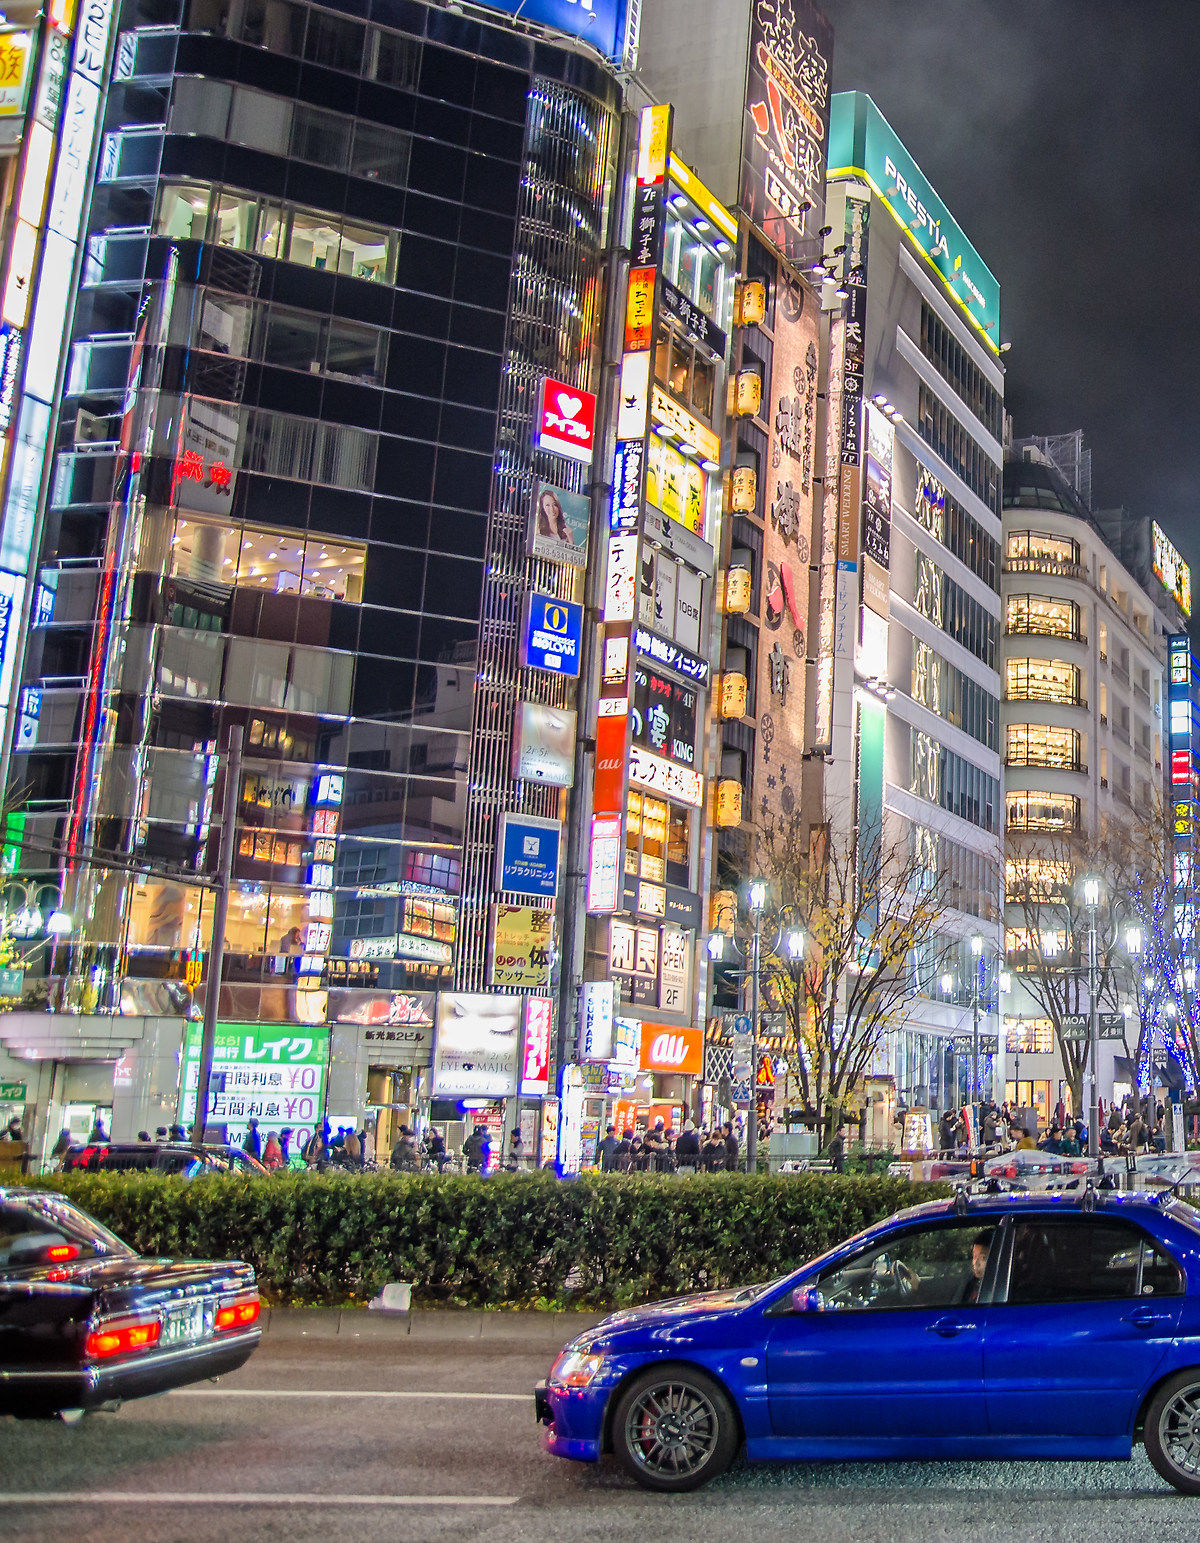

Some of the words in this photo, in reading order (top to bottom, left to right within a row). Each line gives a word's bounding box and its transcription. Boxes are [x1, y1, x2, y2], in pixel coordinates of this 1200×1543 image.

[642, 187, 657, 202] 7F
[885, 155, 950, 260] PRESTIA
[637, 216, 656, 264] 獅子亭
[846, 321, 862, 343] 天
[630, 339, 646, 350] 6F
[545, 411, 590, 439] アイフル
[841, 452, 855, 464] 7F
[841, 521, 850, 556] SMART
[605, 701, 622, 714] 2F
[682, 691, 695, 708] 4F
[672, 738, 694, 763] KING
[598, 757, 623, 770] au
[663, 950, 685, 969] OPEN
[494, 968, 547, 983] マッサージ
[666, 988, 679, 1005] 2F
[584, 998, 594, 1053] SUNPARK
[762, 1013, 783, 1023] モア
[1062, 1016, 1086, 1026] MOA
[1102, 1015, 1122, 1024] モア
[365, 1030, 425, 1042] 新光第2ビル
[244, 1036, 314, 1061] レイク
[652, 1034, 690, 1065] au
[440, 1061, 459, 1072] EYE
[476, 1061, 513, 1073] MAJIC
[287, 1067, 316, 1090] ¥0
[284, 1097, 314, 1120] ¥0
